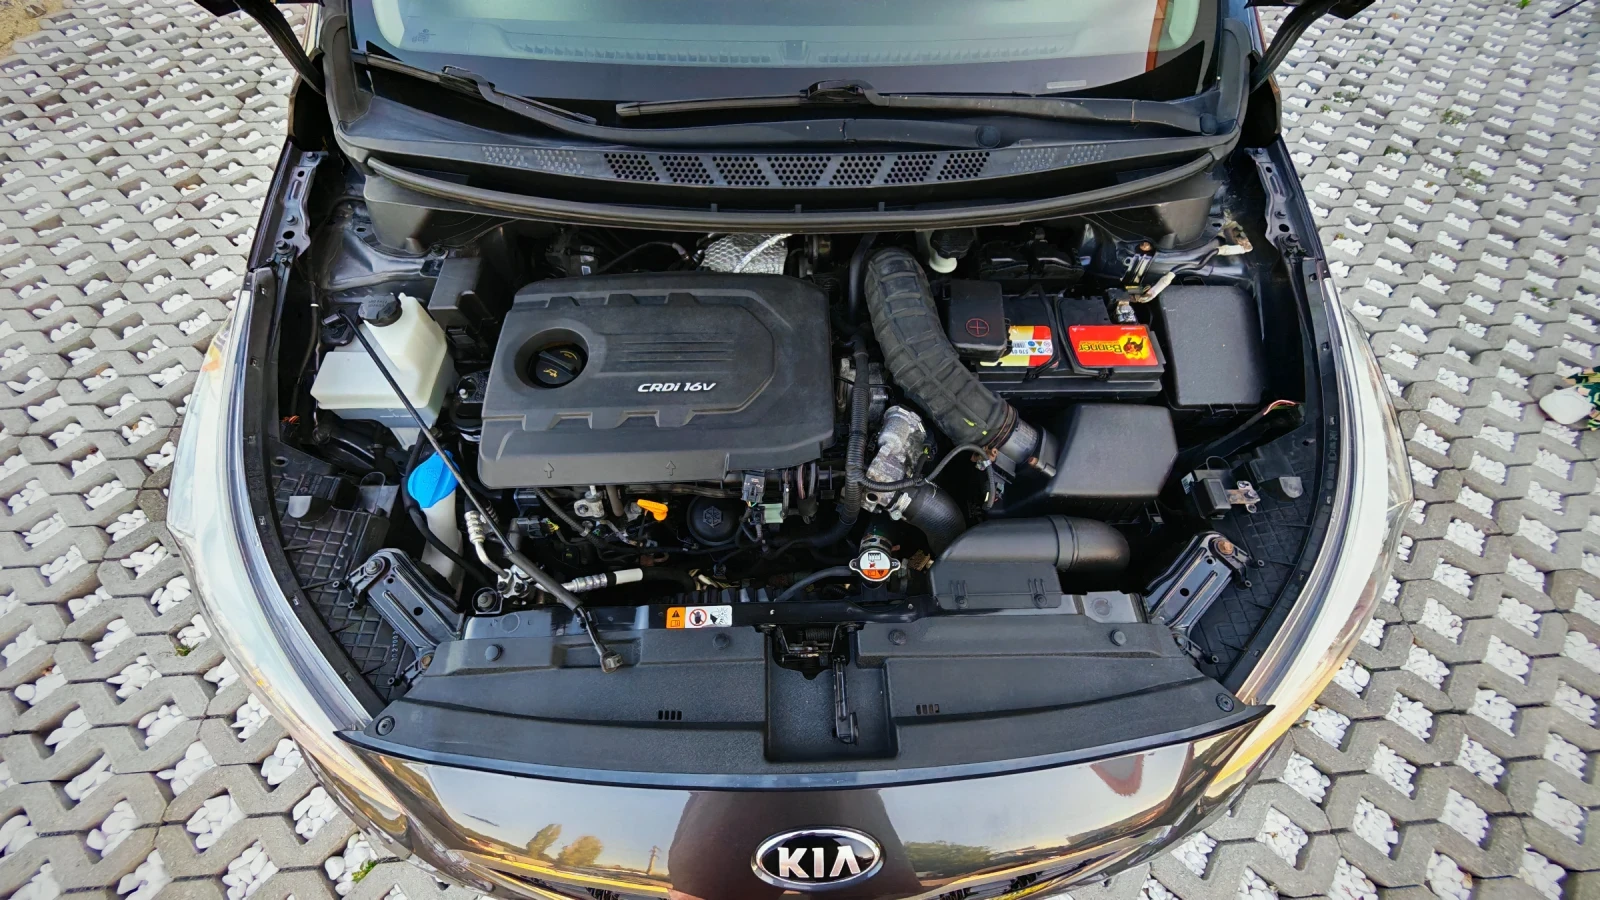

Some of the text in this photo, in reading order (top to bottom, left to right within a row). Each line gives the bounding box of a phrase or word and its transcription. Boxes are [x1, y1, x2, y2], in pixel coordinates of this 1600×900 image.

[1079, 344, 1122, 353] Banner
[683, 382, 717, 392] 16V
[778, 845, 861, 878] KIA
